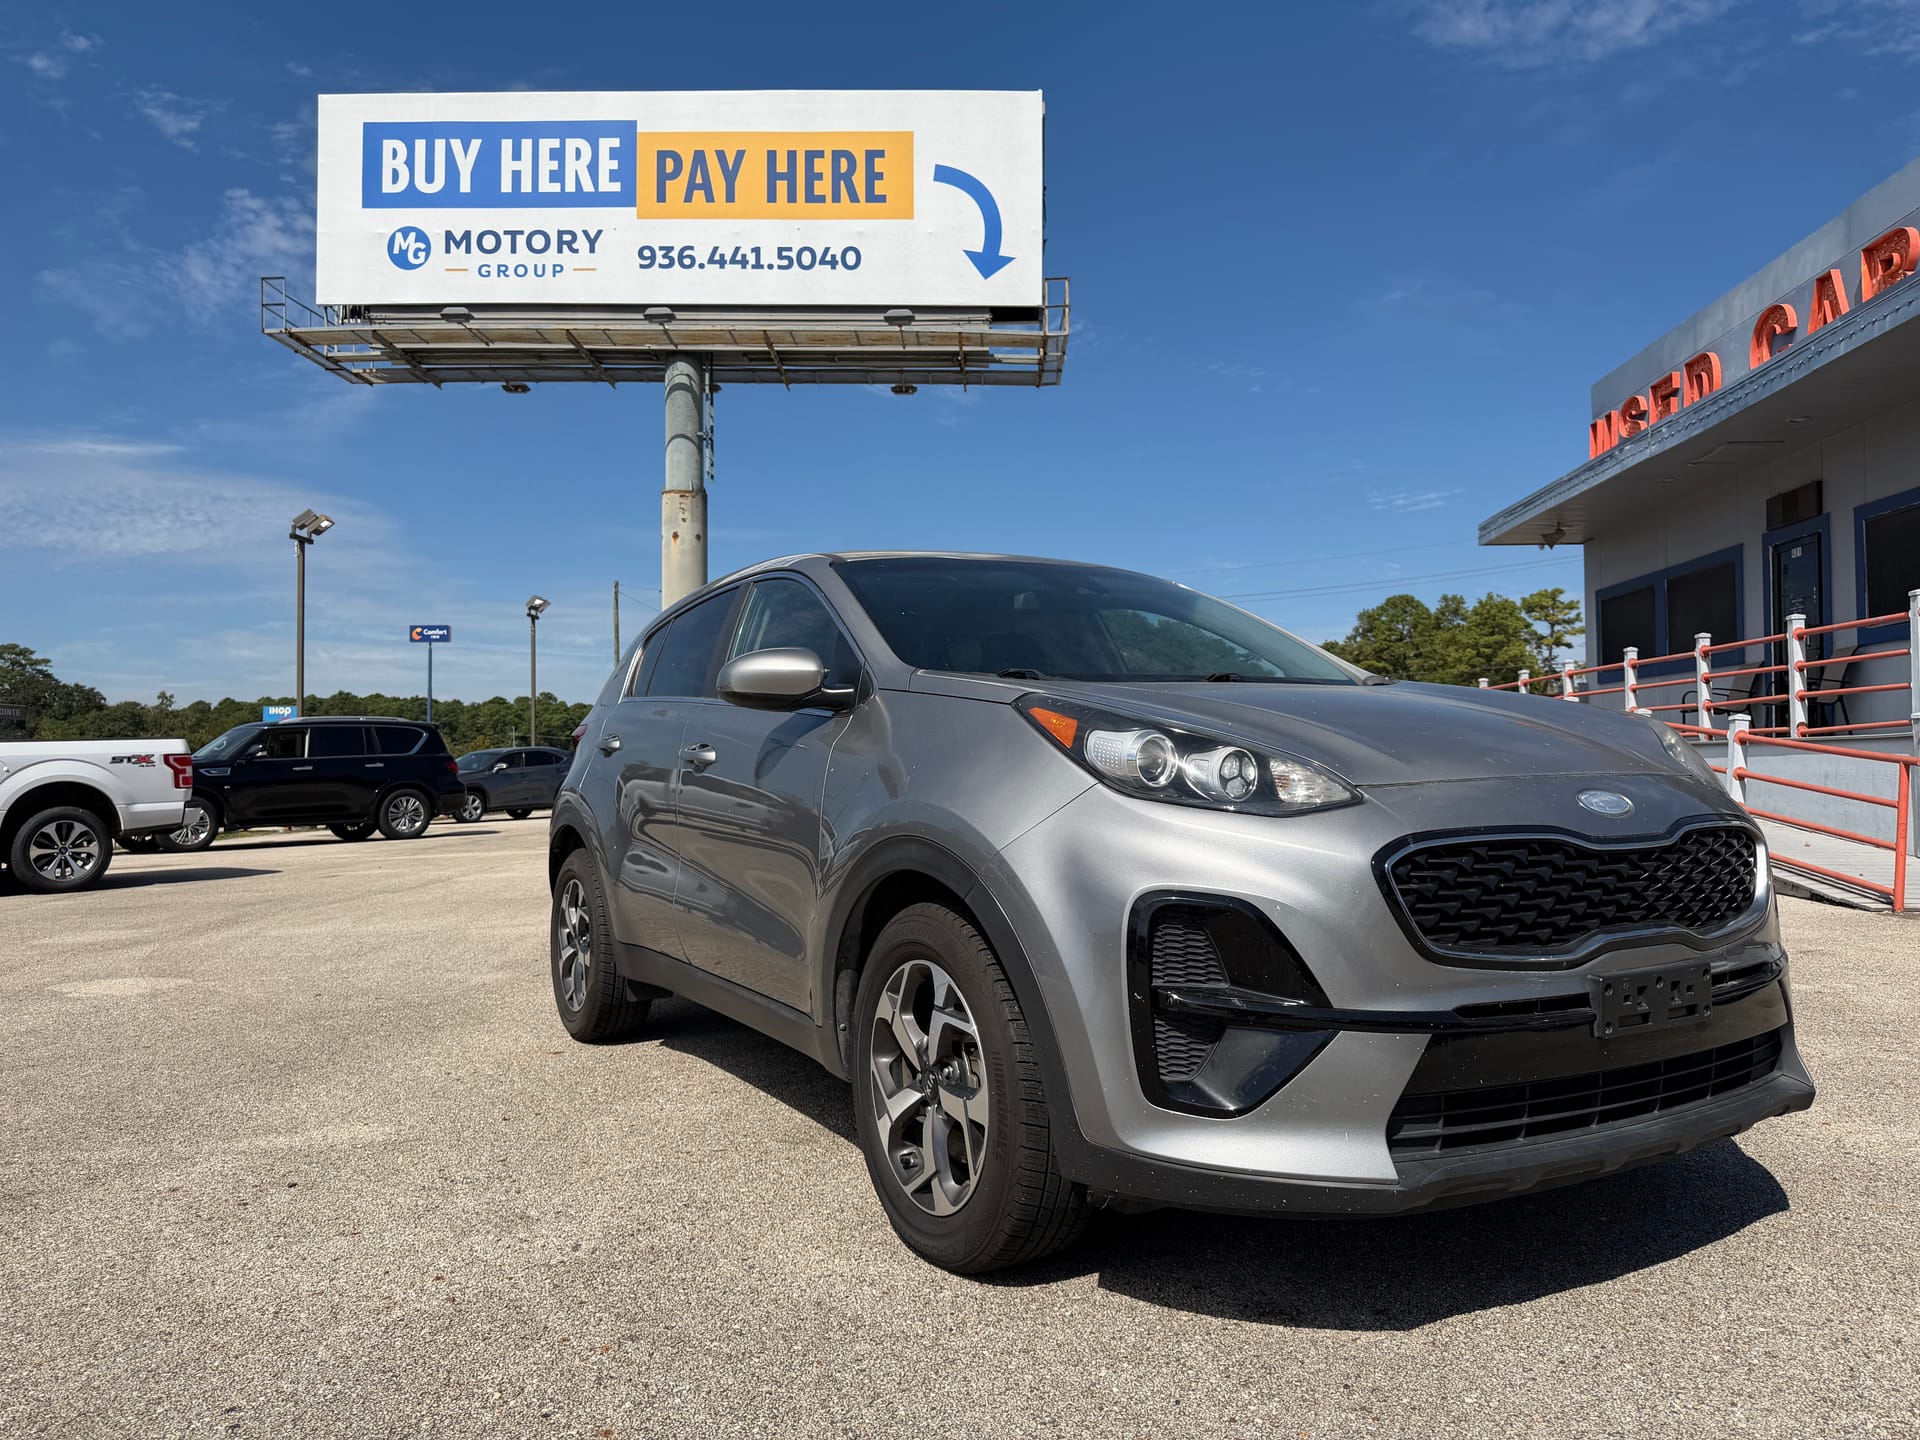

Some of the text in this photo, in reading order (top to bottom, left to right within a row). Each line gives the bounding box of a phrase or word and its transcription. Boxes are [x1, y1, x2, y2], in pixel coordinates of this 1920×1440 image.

[382, 138, 622, 194] BUY HERE
[656, 149, 887, 204] PAY HERE
[392, 231, 427, 265] MG
[444, 229, 604, 255] MOTORY
[477, 263, 565, 278] GROUP
[637, 245, 862, 271] 936.441.5040
[1589, 351, 1722, 461] USED
[423, 628, 448, 636] Comfort
[109, 754, 156, 764] STX
